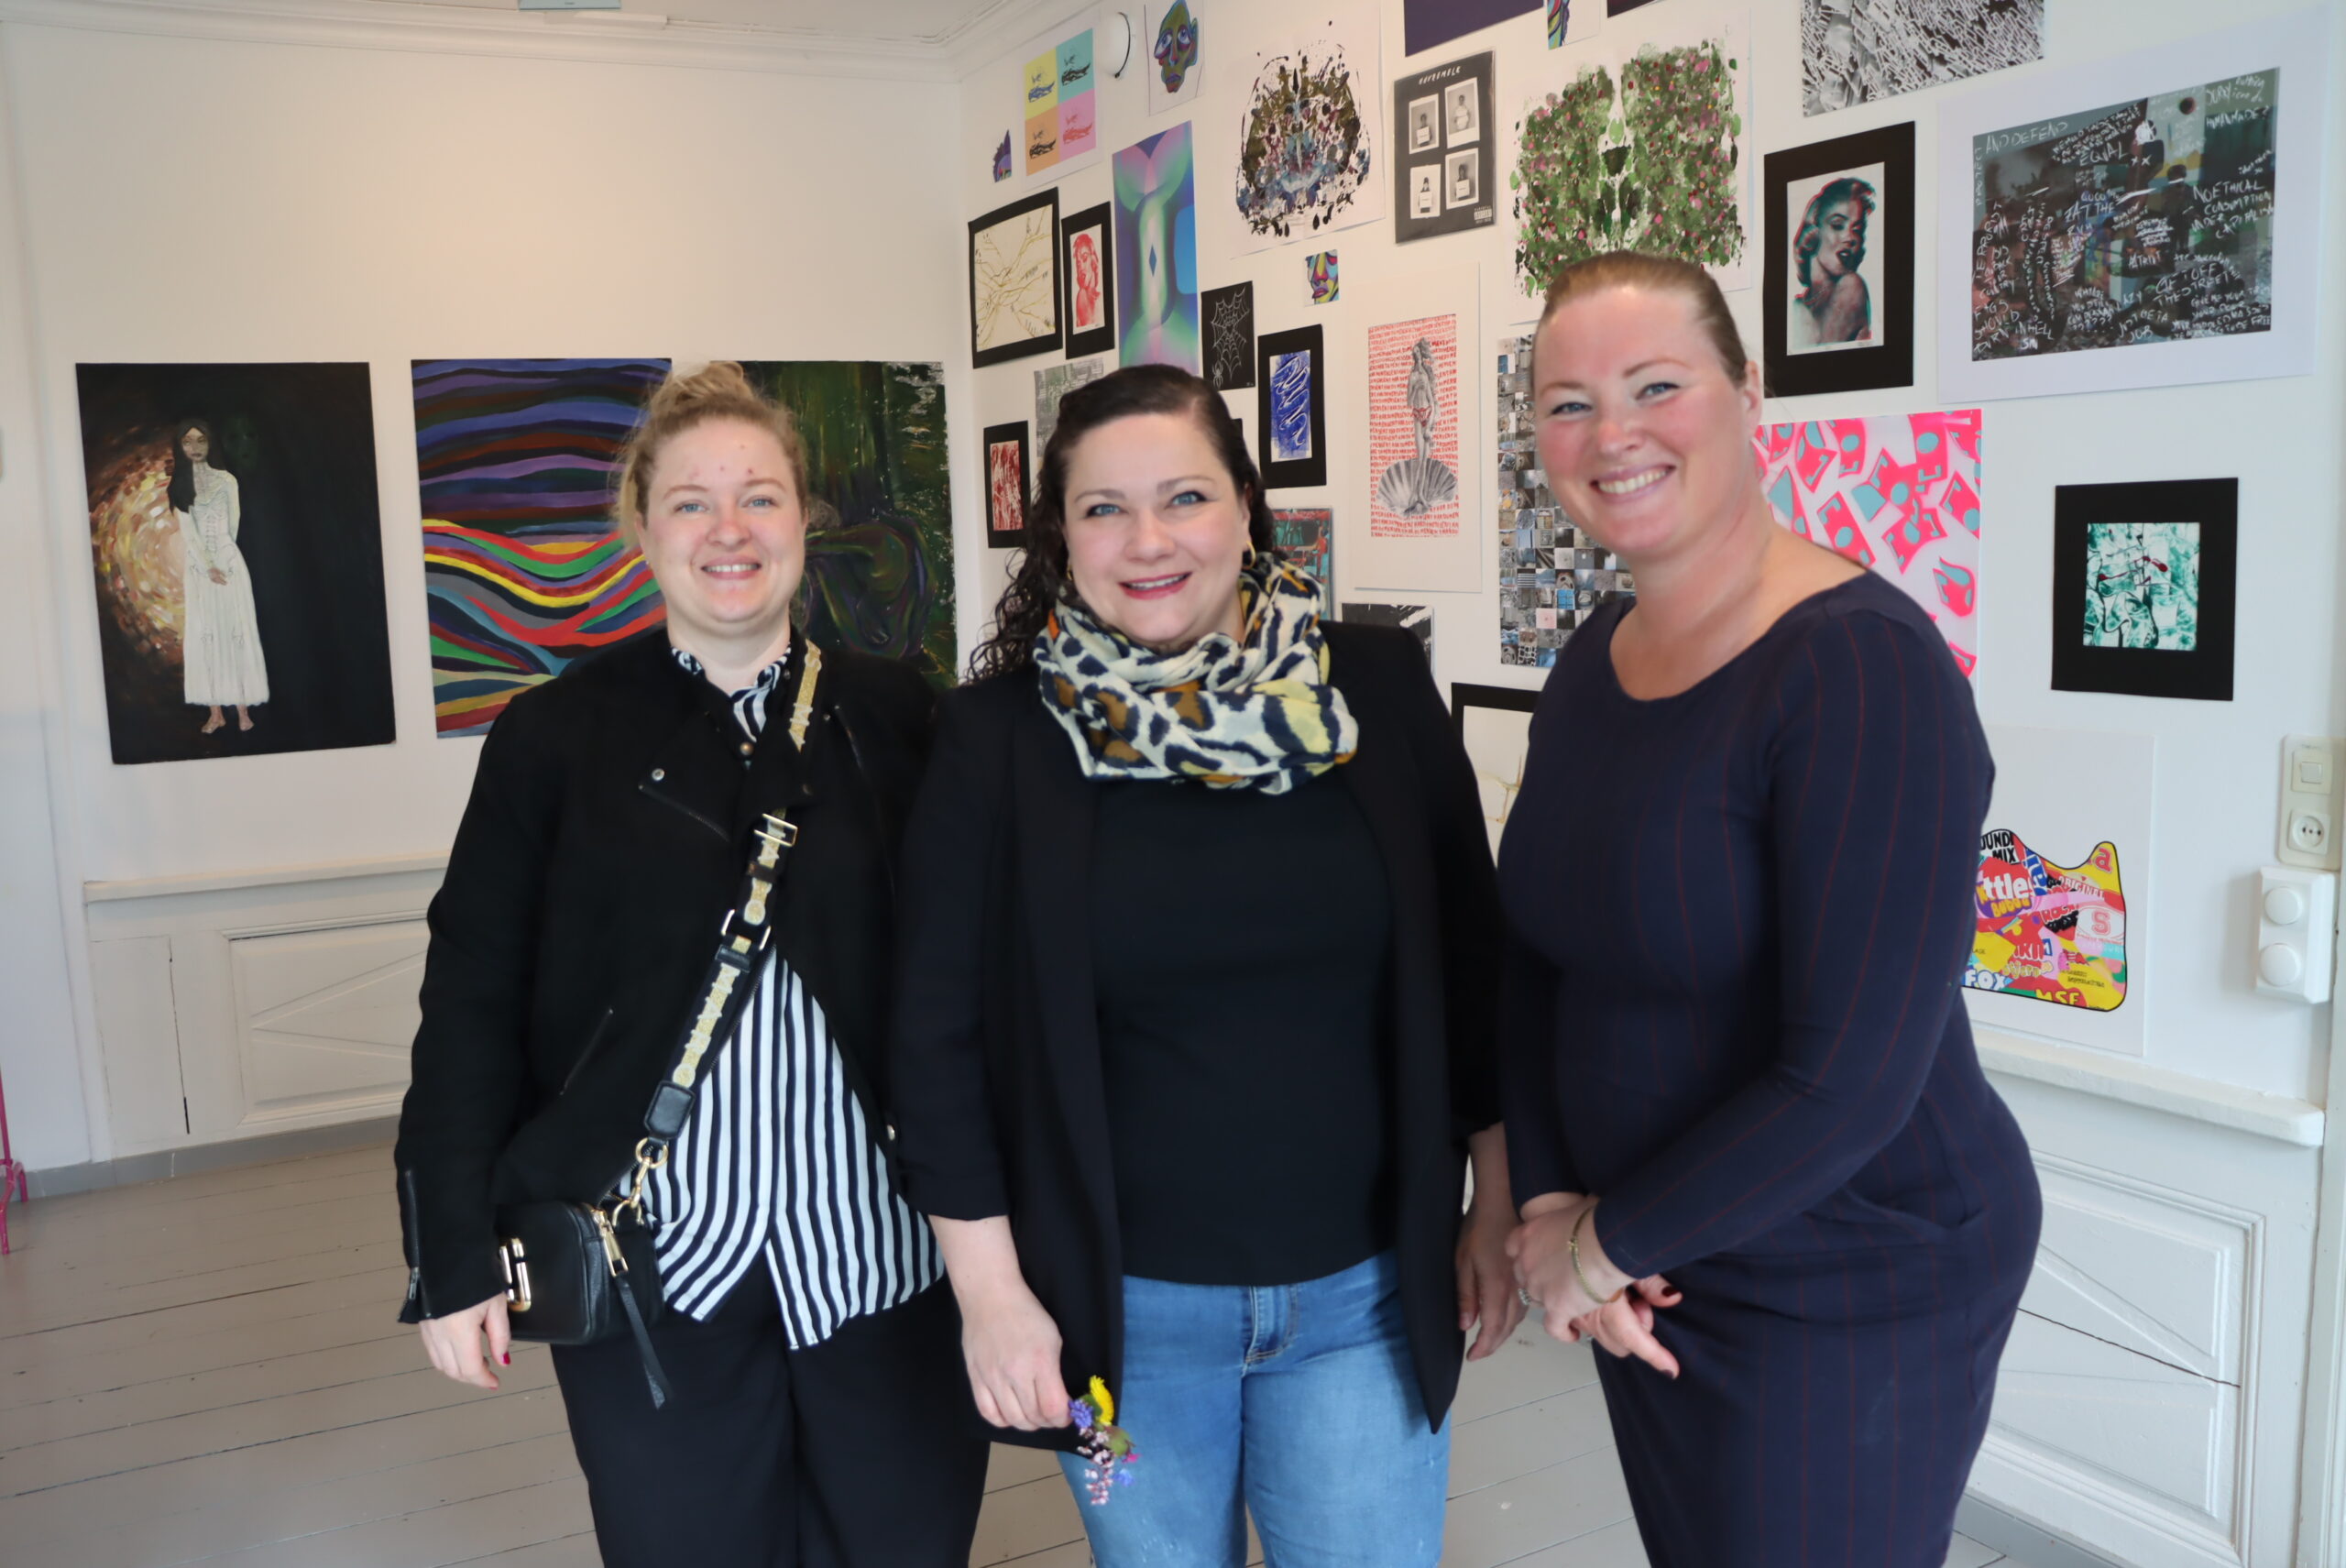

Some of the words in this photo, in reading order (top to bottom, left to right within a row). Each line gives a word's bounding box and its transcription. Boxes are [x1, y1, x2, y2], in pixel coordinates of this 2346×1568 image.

[2080, 141, 2128, 167] EQUAL
[2058, 876, 2105, 899] ORIGINAL
[1964, 969, 2006, 991] FOX
